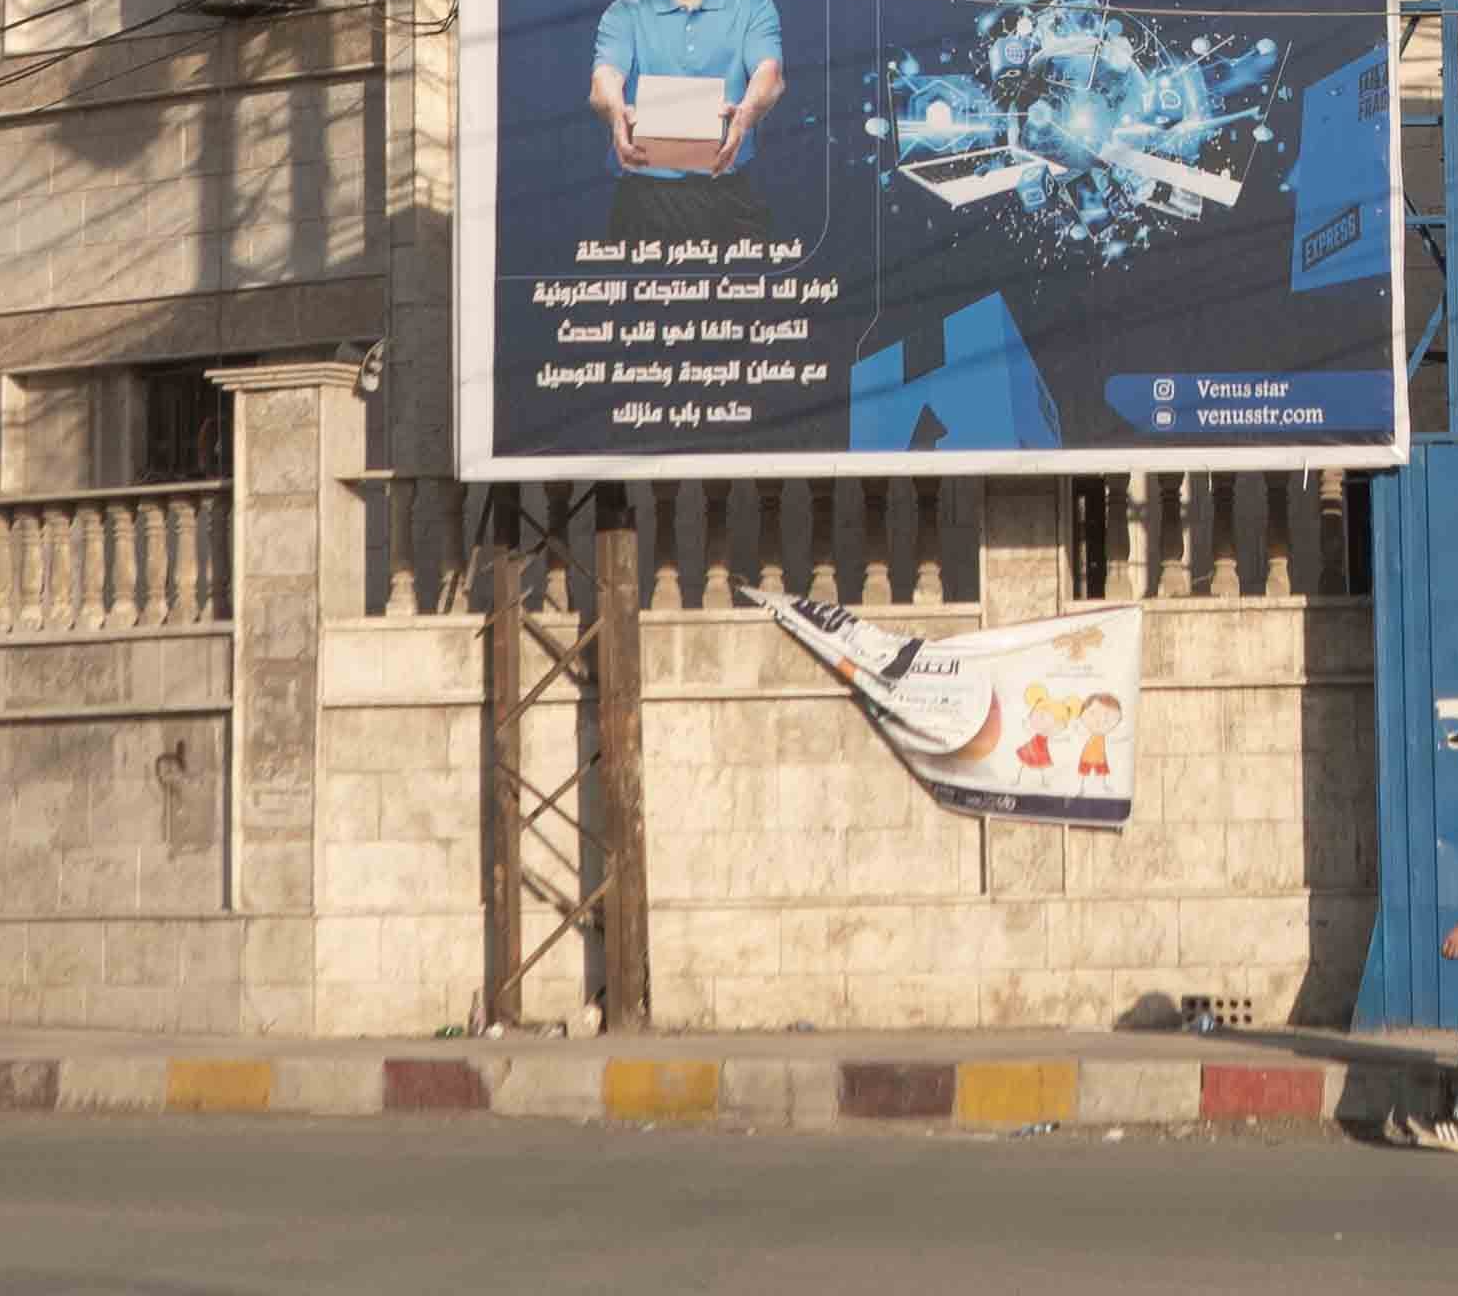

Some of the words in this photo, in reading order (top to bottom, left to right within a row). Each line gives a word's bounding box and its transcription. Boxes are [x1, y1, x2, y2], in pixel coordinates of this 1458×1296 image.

[575, 240, 626, 263] لحظة
[631, 240, 662, 264] كل
[667, 240, 718, 266] يتطور
[724, 238, 764, 265] عالم
[769, 238, 802, 264] في
[633, 279, 710, 306] المنتجات
[771, 278, 797, 300] لك
[800, 278, 839, 305] نوفر
[557, 319, 614, 343] الحدث
[620, 320, 656, 346] قلب
[662, 320, 695, 346] في
[750, 319, 809, 344] لتكون
[537, 362, 606, 388] التوصيل
[611, 362, 673, 386] وخدمة
[678, 360, 740, 386] الجودة
[746, 360, 796, 384] ضمان
[800, 363, 828, 385] مع
[1197, 380, 1251, 399] Venus
[1254, 380, 1289, 398] star
[612, 401, 663, 428] منزلك
[669, 401, 701, 427] باب
[706, 401, 752, 422] حتى
[1197, 406, 1324, 426] venusstr.com
